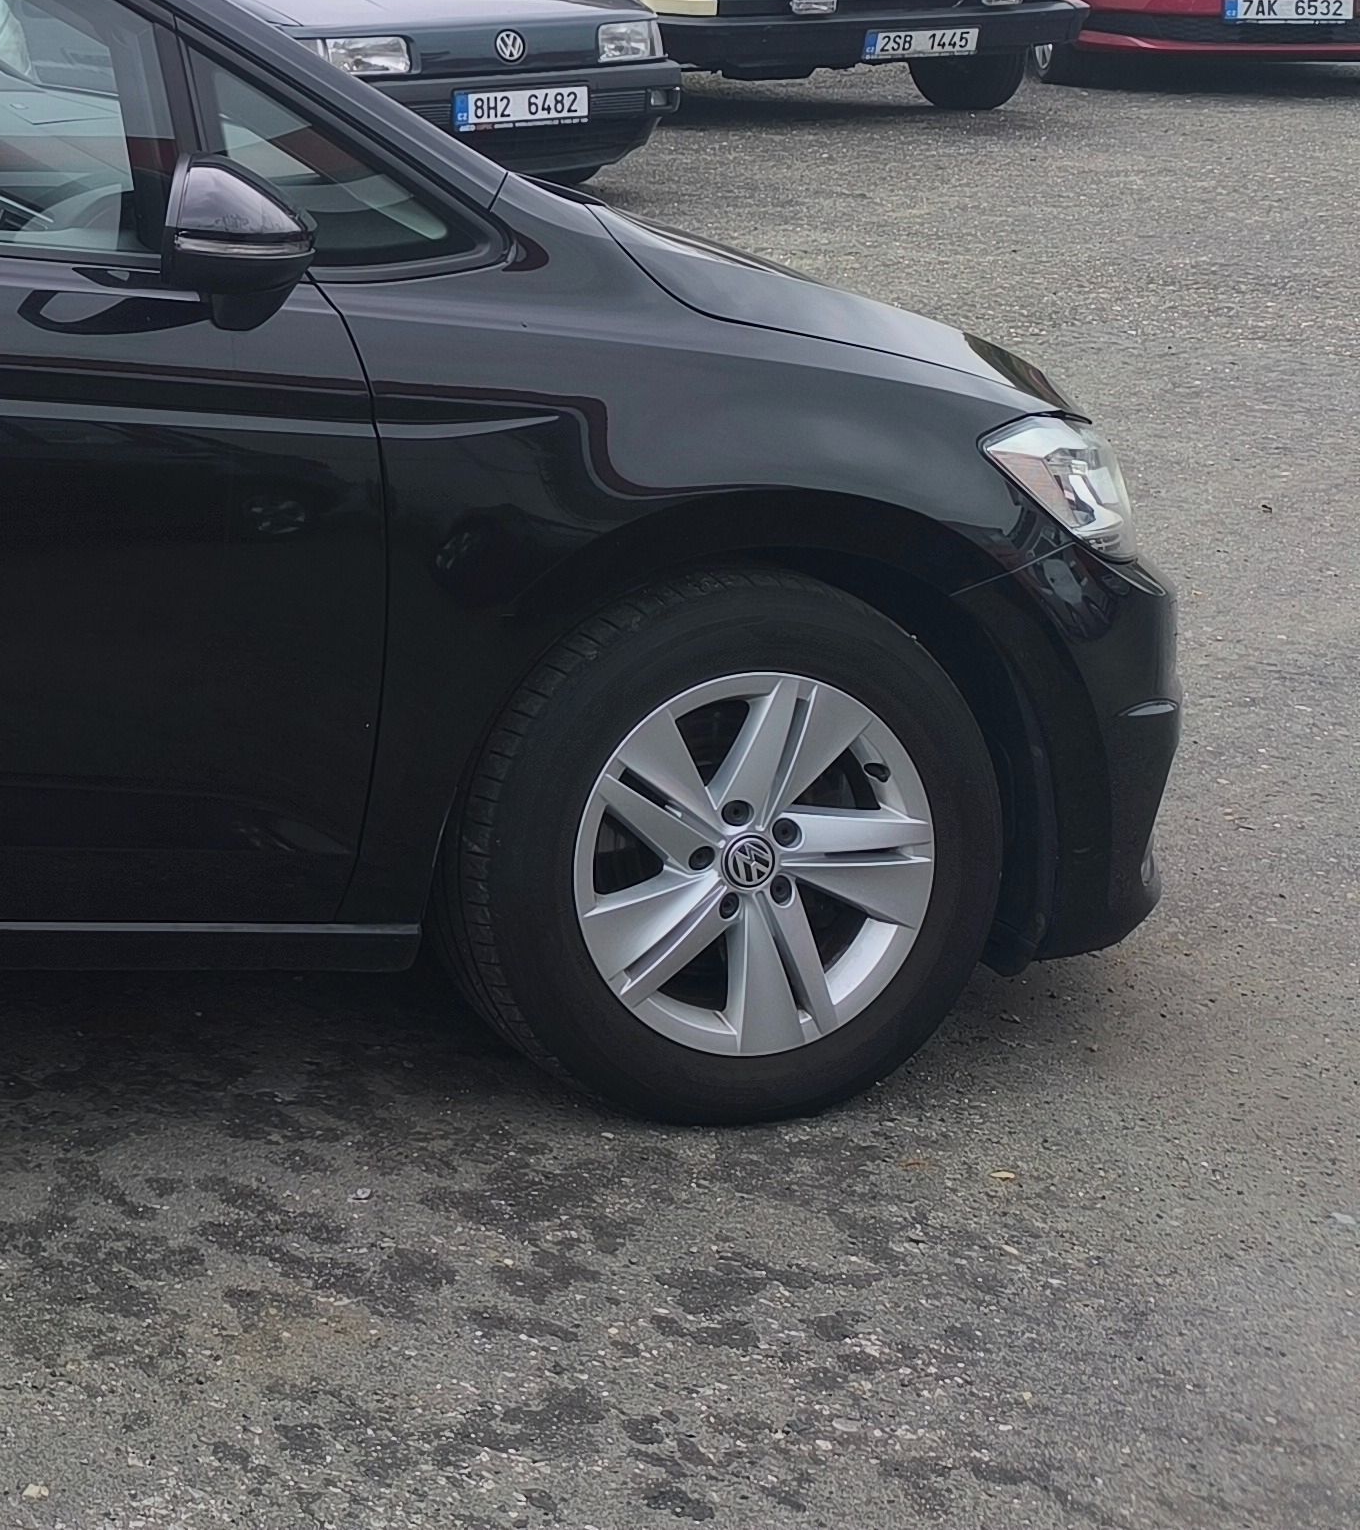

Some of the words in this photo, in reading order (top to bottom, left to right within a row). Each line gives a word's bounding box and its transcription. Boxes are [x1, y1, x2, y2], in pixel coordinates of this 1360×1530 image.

[1242, 0, 1278, 16] 7AK
[1294, 0, 1343, 16] 6532
[880, 34, 913, 53] 2SB
[928, 31, 970, 50] 1445
[473, 96, 511, 119] 8H2
[527, 91, 578, 115] 6482
[457, 112, 468, 121] CZ
